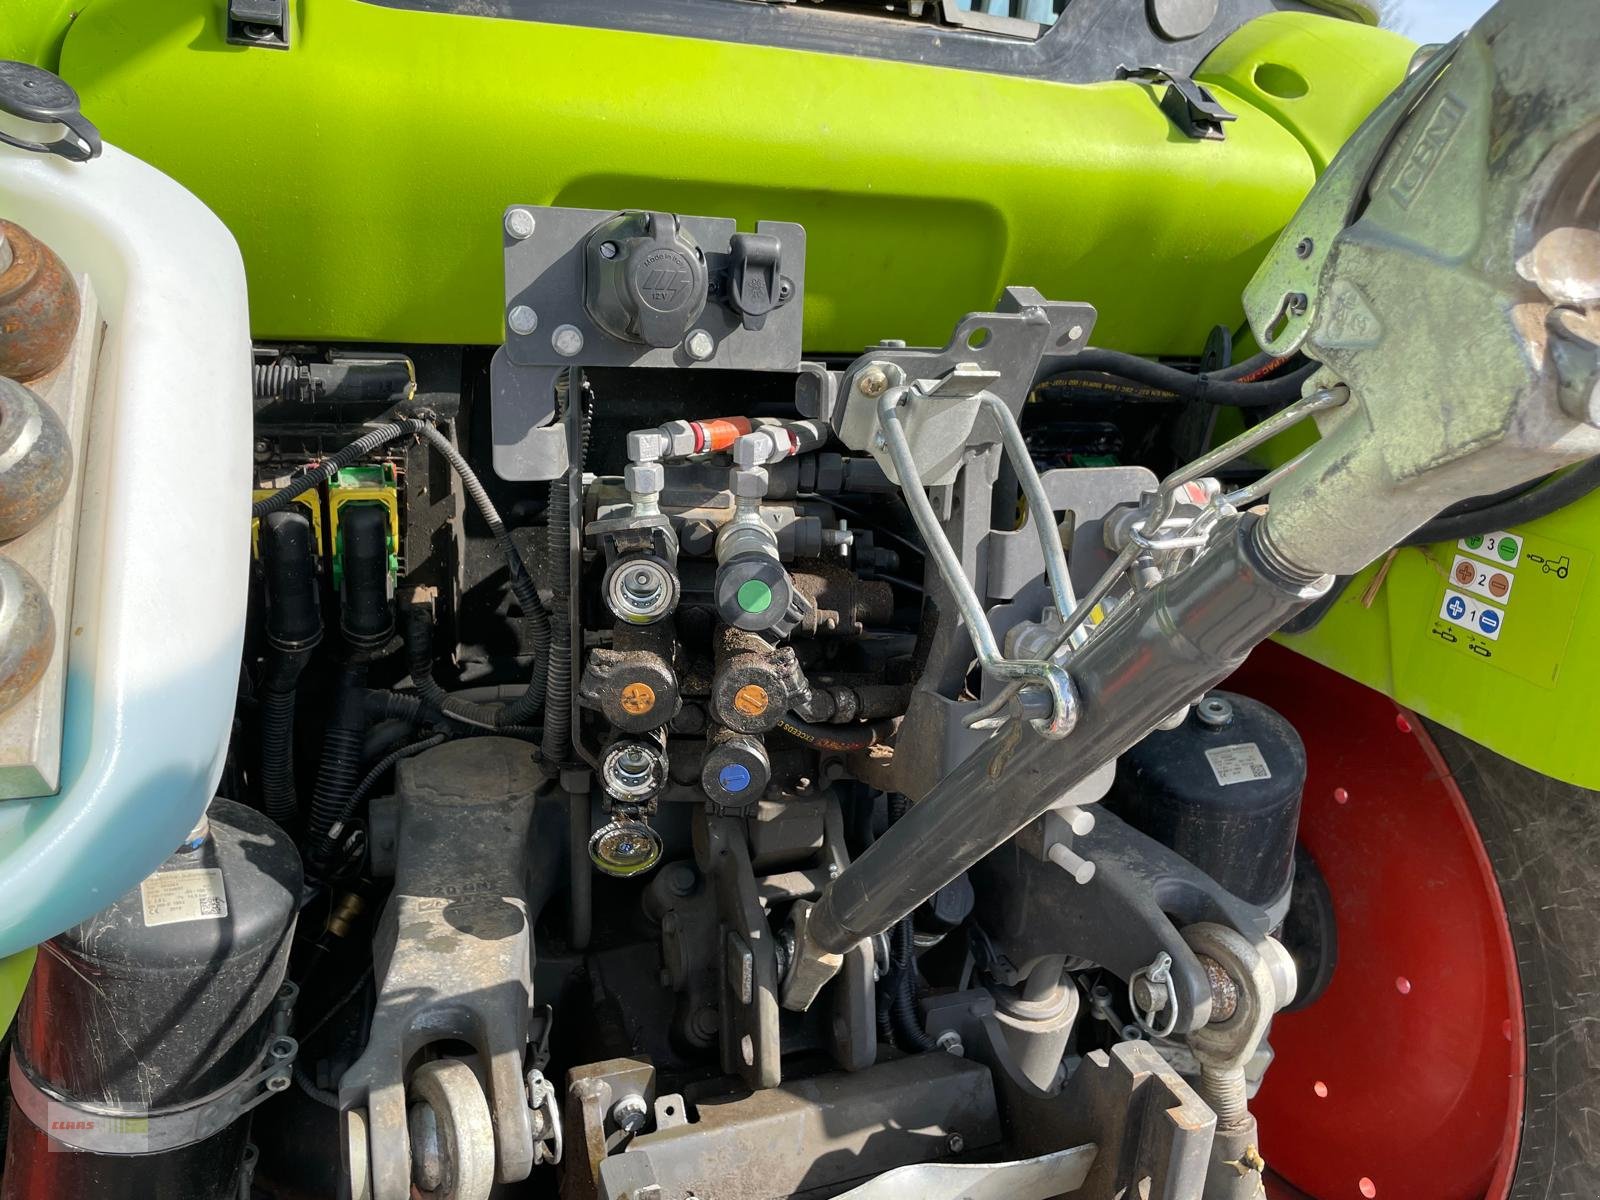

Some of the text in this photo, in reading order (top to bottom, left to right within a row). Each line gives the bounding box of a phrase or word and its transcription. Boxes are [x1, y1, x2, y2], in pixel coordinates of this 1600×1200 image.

[652, 291, 668, 301] 12V
[1487, 538, 1495, 551] 3
[1478, 574, 1487, 587] 2
[1470, 610, 1477, 622] 1
[783, 722, 815, 743] EXCEEDS
